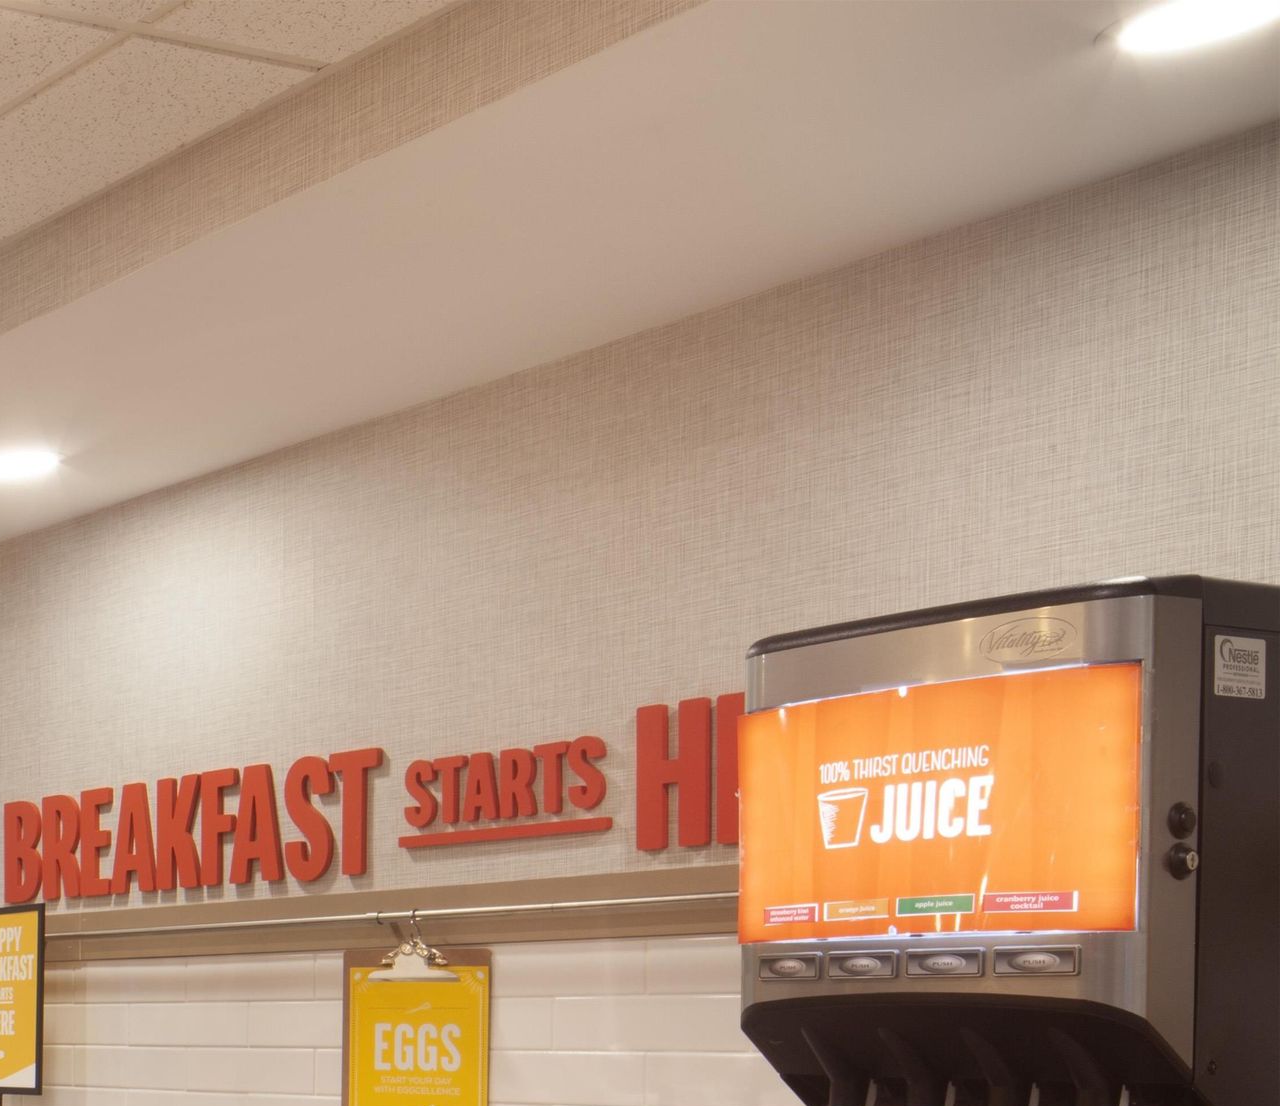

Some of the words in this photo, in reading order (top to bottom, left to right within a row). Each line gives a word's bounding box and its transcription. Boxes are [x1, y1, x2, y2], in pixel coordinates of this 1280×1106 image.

[819, 761, 850, 784] 100%
[853, 754, 899, 780] THIRST
[901, 745, 989, 775] QUENCHING
[3, 747, 383, 904] BREAKFAST
[404, 735, 607, 828] STARTS
[870, 775, 994, 844] JUICE
[914, 901, 934, 909] apple
[935, 900, 953, 908] juice
[996, 895, 1036, 903] cranberry
[1037, 893, 1060, 902] juice
[1010, 902, 1043, 910] cocktail
[374, 1022, 462, 1072] EGGS
